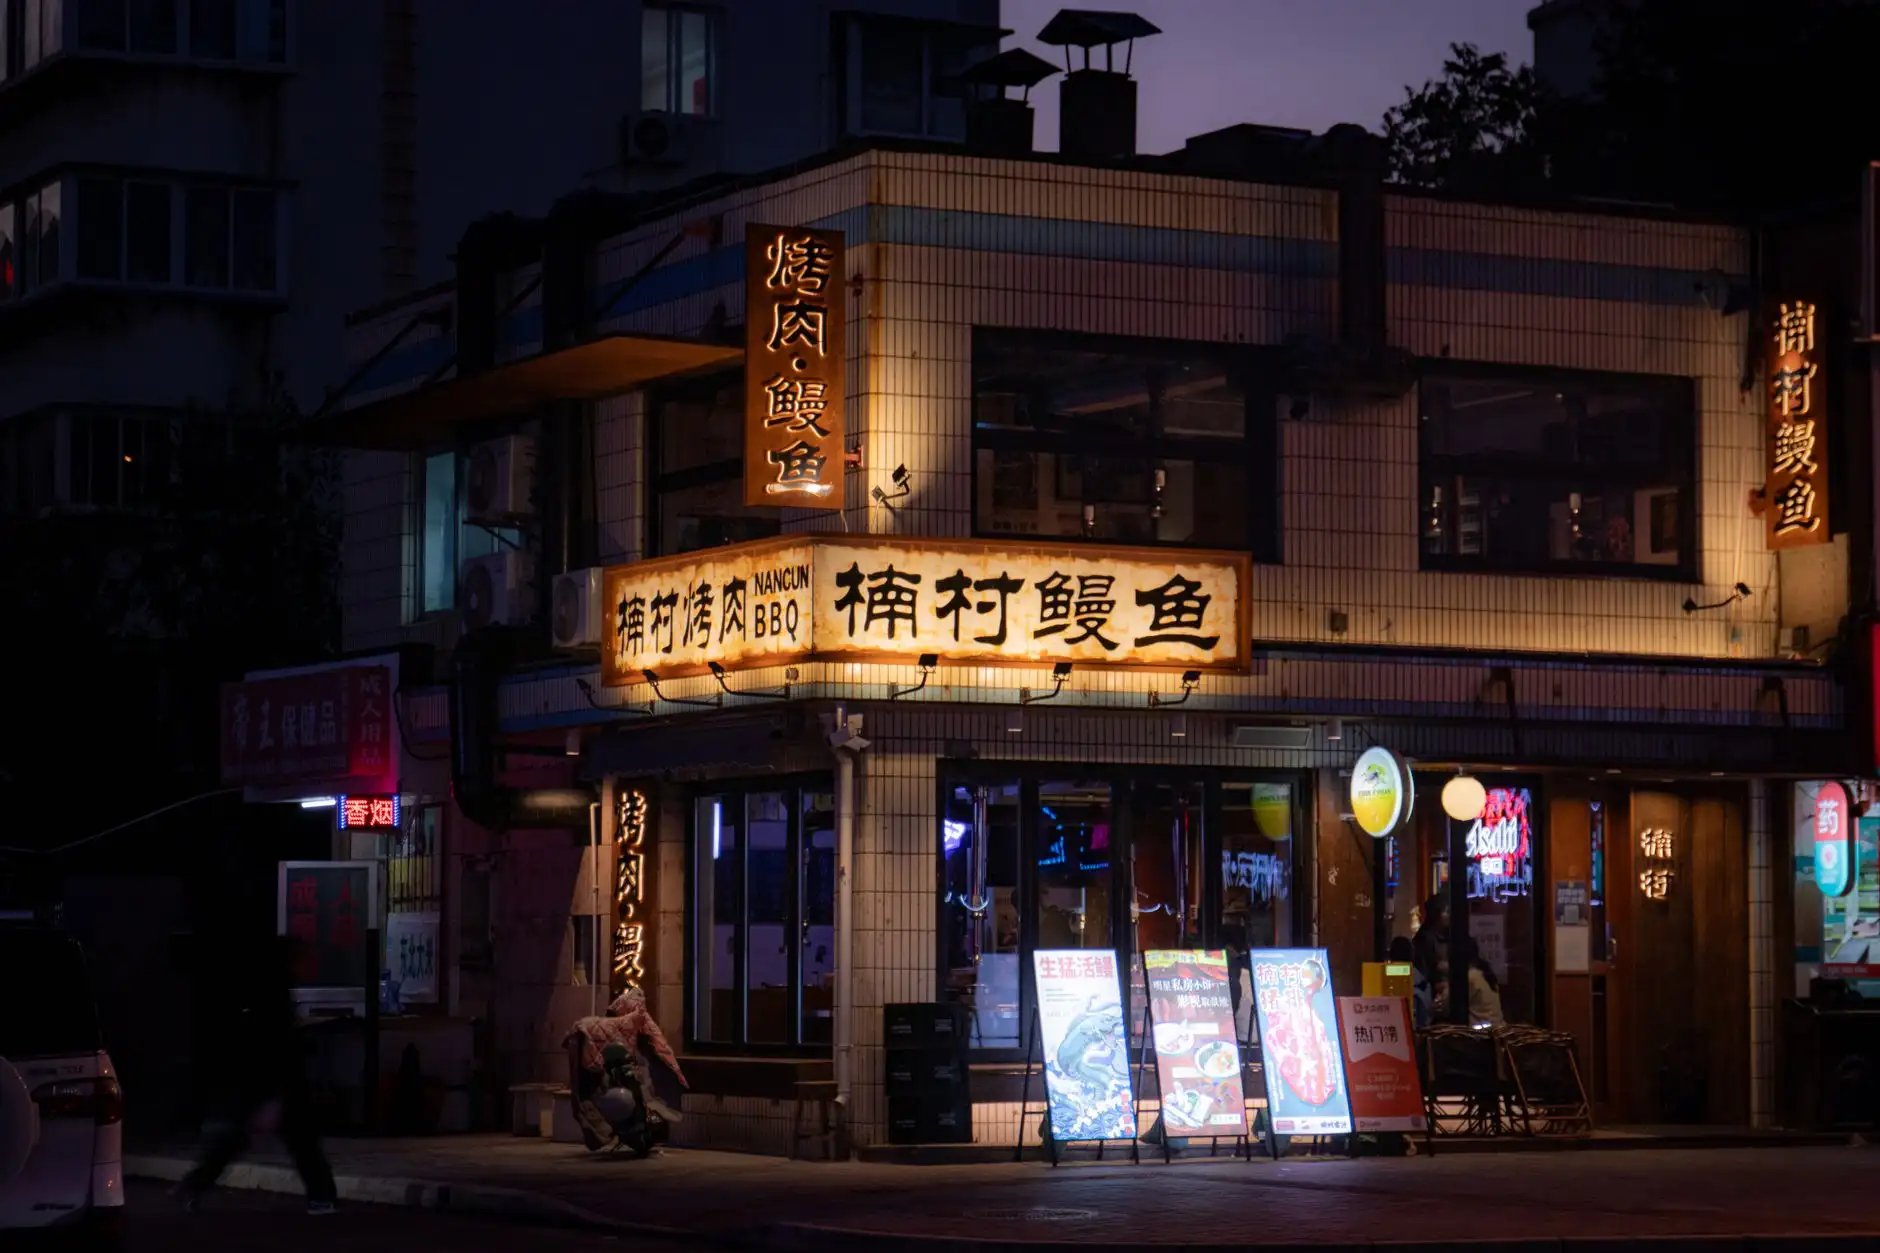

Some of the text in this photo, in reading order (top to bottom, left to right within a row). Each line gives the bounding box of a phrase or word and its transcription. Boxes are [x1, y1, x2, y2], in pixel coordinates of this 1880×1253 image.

[754, 564, 810, 596] NANCUN
[834, 561, 1220, 651] 楠村鳗鱼
[616, 575, 749, 658] 楠村烤肉
[754, 599, 799, 642] BBQ
[345, 799, 394, 826] 香烟
[614, 788, 649, 996] 烤肉·鳗
